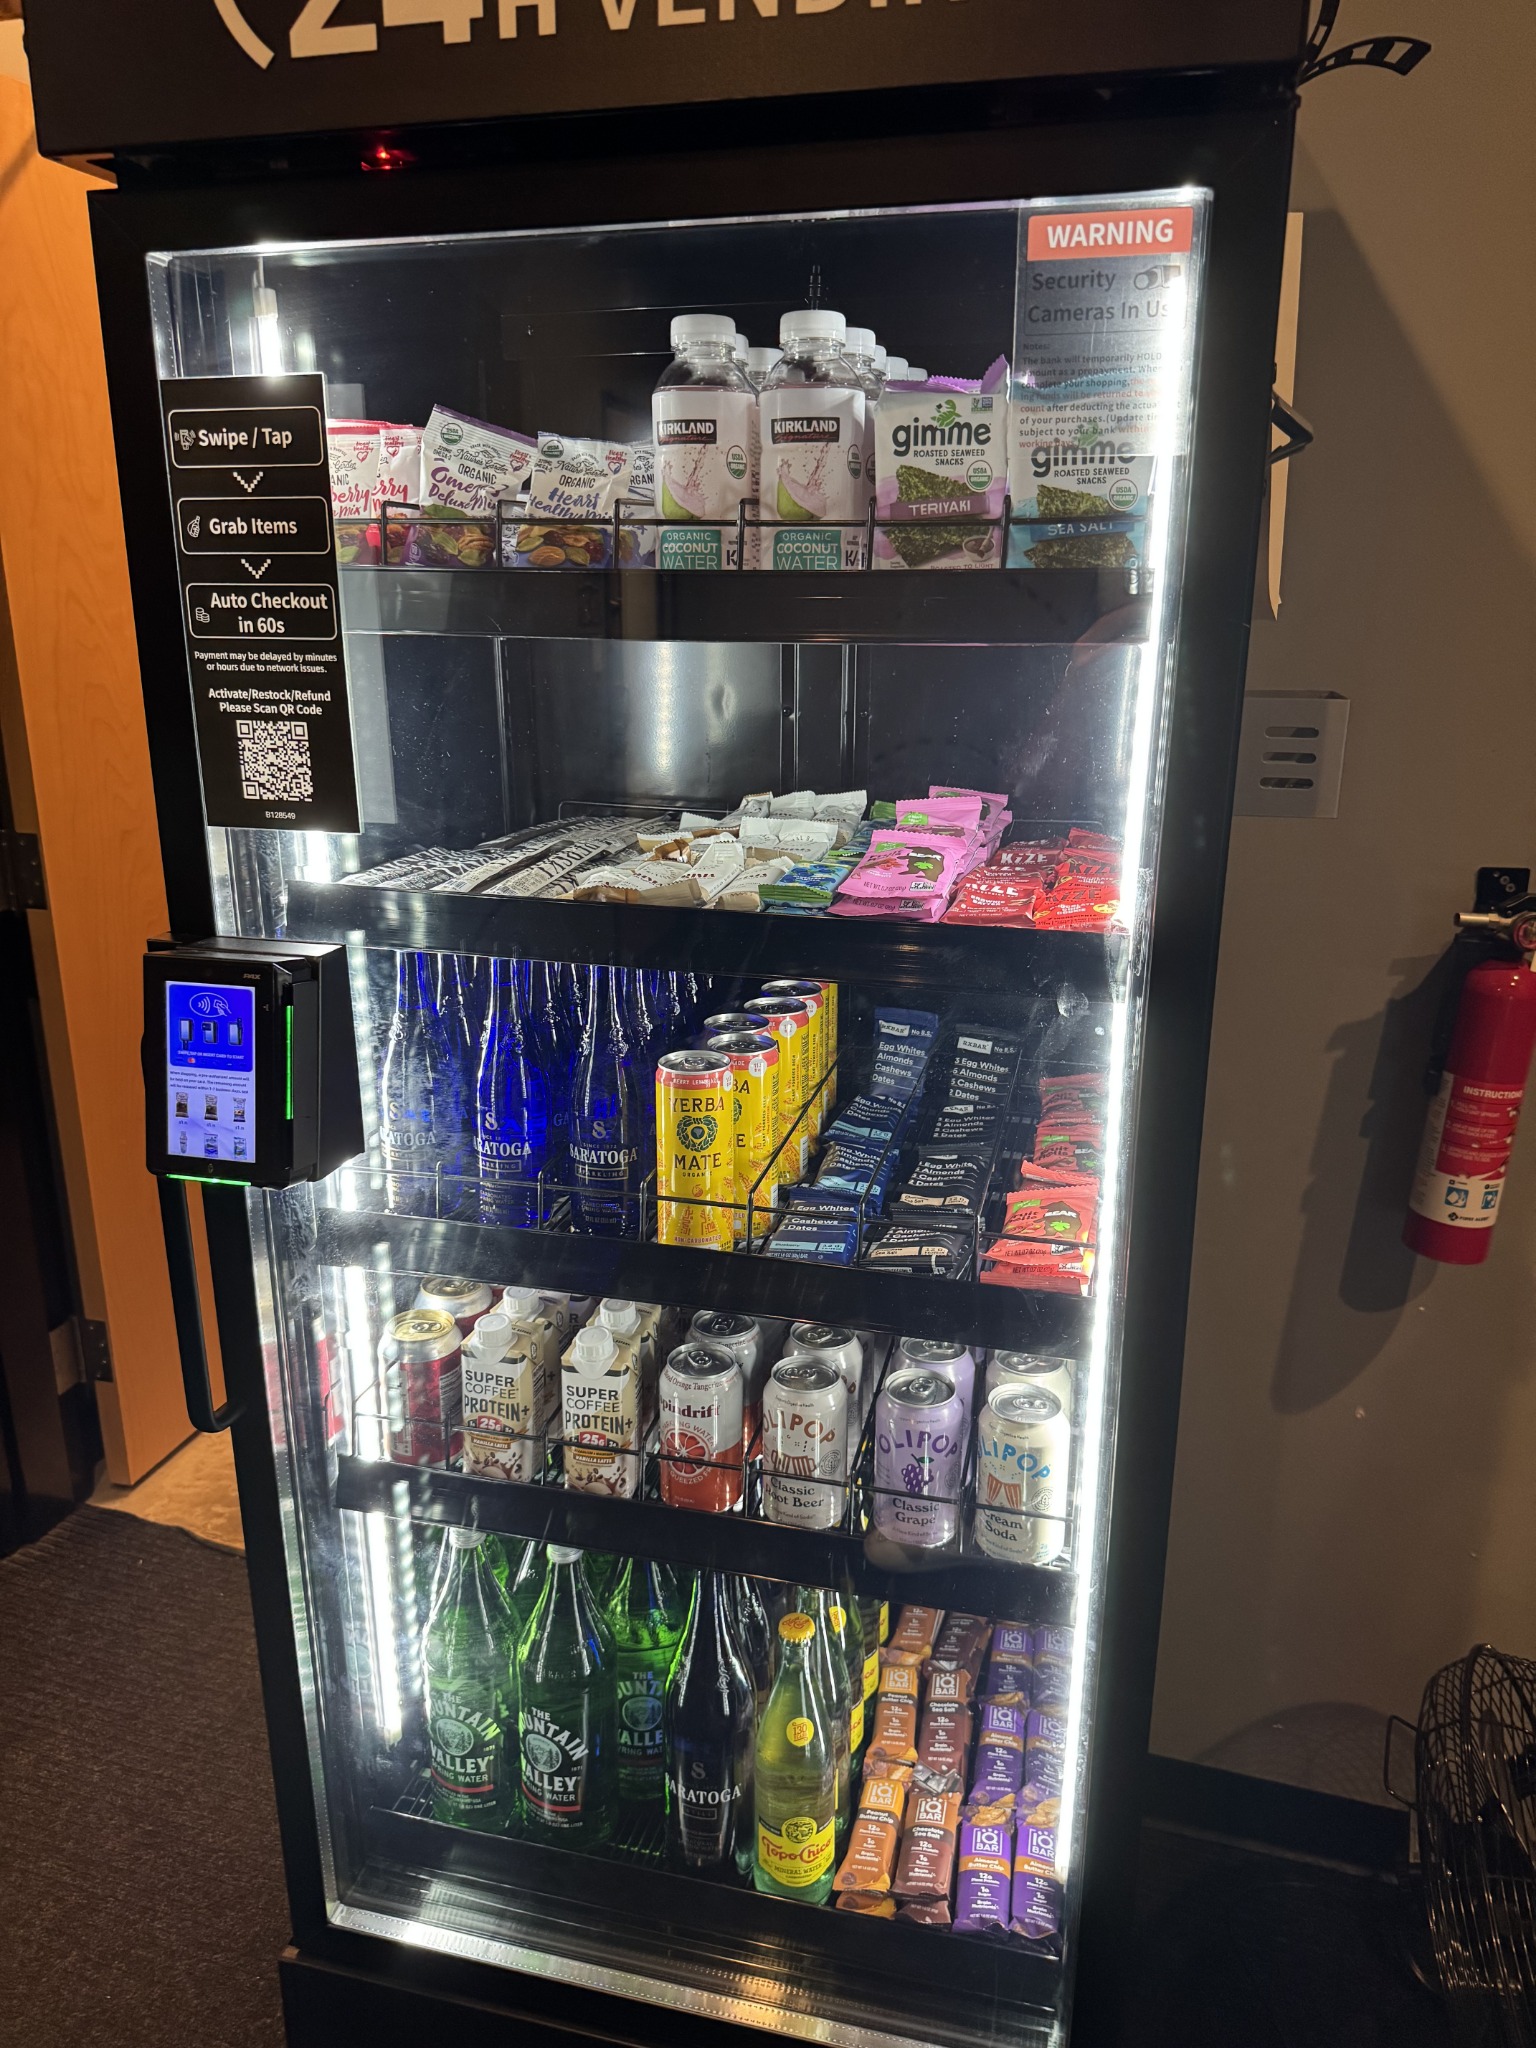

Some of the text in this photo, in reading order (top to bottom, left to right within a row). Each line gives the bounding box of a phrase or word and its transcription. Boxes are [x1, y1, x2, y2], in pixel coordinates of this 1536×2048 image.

[1047, 219, 1174, 248] WARNING
[1032, 269, 1116, 291] Security
[1028, 305, 1115, 323] Cameras
[1121, 302, 1139, 319] In
[1082, 353, 1135, 364] temporarily
[1020, 402, 1130, 413] count after deducting the
[658, 420, 715, 435] KIRKLAND
[774, 419, 838, 433] KIRKLAND
[1020, 416, 1052, 426] of your
[198, 428, 249, 450] Swipe
[261, 428, 292, 448] Tap
[892, 417, 992, 457] gimme
[1019, 427, 1089, 438] subject to your
[914, 448, 985, 458] ROASTED SEAWEED
[1031, 437, 1137, 478] gimme
[935, 458, 964, 466] SNACKS
[458, 463, 497, 485] ORGANIC
[1054, 467, 1130, 478] ROASTED SEAWEED
[559, 475, 596, 489] ORGANIC
[1076, 477, 1107, 485] SNACKS
[428, 482, 473, 510] Deluxe
[548, 487, 600, 510] Heart
[908, 500, 972, 516] TERIYAKI
[209, 517, 297, 535] Grab Items
[1048, 523, 1074, 536] SEA
[667, 532, 711, 541] ORGANIC
[782, 532, 832, 541] ORGANIC
[662, 543, 718, 554] COCONUT
[777, 543, 838, 554] COCONUT
[662, 555, 718, 570] WATER
[776, 555, 838, 570] WATER
[210, 592, 328, 610] Auto Checkout
[238, 616, 285, 634] in 60s
[194, 651, 338, 663] Payment may be delayed by minutes
[216, 663, 239, 672] hours
[239, 663, 256, 672] due
[256, 664, 265, 672] to
[266, 664, 299, 673] network
[300, 664, 327, 673] issues.
[208, 688, 331, 702] Activate/Restock/Refund
[219, 703, 323, 716] Please Scan QR Code
[879, 1041, 926, 1057] Egg Whites
[962, 1040, 989, 1050] RXBAR
[876, 1053, 914, 1066] Almonds
[961, 1058, 1009, 1073] Egg Whites
[874, 1063, 912, 1077] Cashews
[959, 1068, 998, 1082] Almonds
[872, 1073, 895, 1085] Dates
[957, 1079, 996, 1093] Cashews
[954, 1090, 979, 1101] Dates
[669, 1096, 724, 1113] YERBA
[570, 1142, 638, 1165] SARATOGA
[674, 1152, 722, 1170] MATE
[791, 1217, 838, 1225] Cashews
[464, 1369, 514, 1388] SUPER
[673, 1378, 692, 1390] Orange
[464, 1383, 516, 1400] COFFEE
[566, 1385, 619, 1401] SUPER
[464, 1395, 530, 1422] PROTEIN+
[566, 1397, 621, 1413] COFFEE
[660, 1397, 721, 1418] pindrift
[565, 1410, 633, 1436] PROTEIN+
[472, 1438, 508, 1449] VANILLA LATTE
[878, 1429, 959, 1459] OLIPOP
[575, 1454, 613, 1465] VANILLA LATTE
[771, 1476, 815, 1496] Classic
[792, 1496, 825, 1508] Beer
[892, 1497, 940, 1513] Classic
[895, 1511, 936, 1527] Grape
[983, 1508, 1023, 1530] Cream
[985, 1520, 1018, 1542] Soda
[633, 1671, 653, 1680] THE
[889, 1669, 909, 1680] IQ
[936, 1675, 955, 1687] IQ
[888, 1679, 909, 1688] BAR
[887, 1692, 908, 1700] Peanut
[935, 1687, 955, 1695] BAR
[443, 1693, 462, 1704] THE
[531, 1706, 551, 1720] THE
[993, 1707, 1015, 1721] IQ
[992, 1719, 1015, 1729] BAR
[457, 1774, 488, 1784] WATER
[545, 1793, 575, 1802] WATER
[872, 1784, 893, 1797] IQ
[871, 1795, 892, 1805] BAR
[866, 1809, 889, 1817] Peanut
[921, 1802, 943, 1814] IQ
[919, 1812, 942, 1821] BAR
[912, 1827, 944, 1836] Chocolate
[977, 1831, 999, 1845] IQ
[976, 1843, 999, 1852] BAR
[1032, 1833, 1056, 1848] IQ
[762, 1835, 832, 1864] Topo Chico
[1031, 1847, 1055, 1859] BAR
[974, 1857, 998, 1865] Almond
